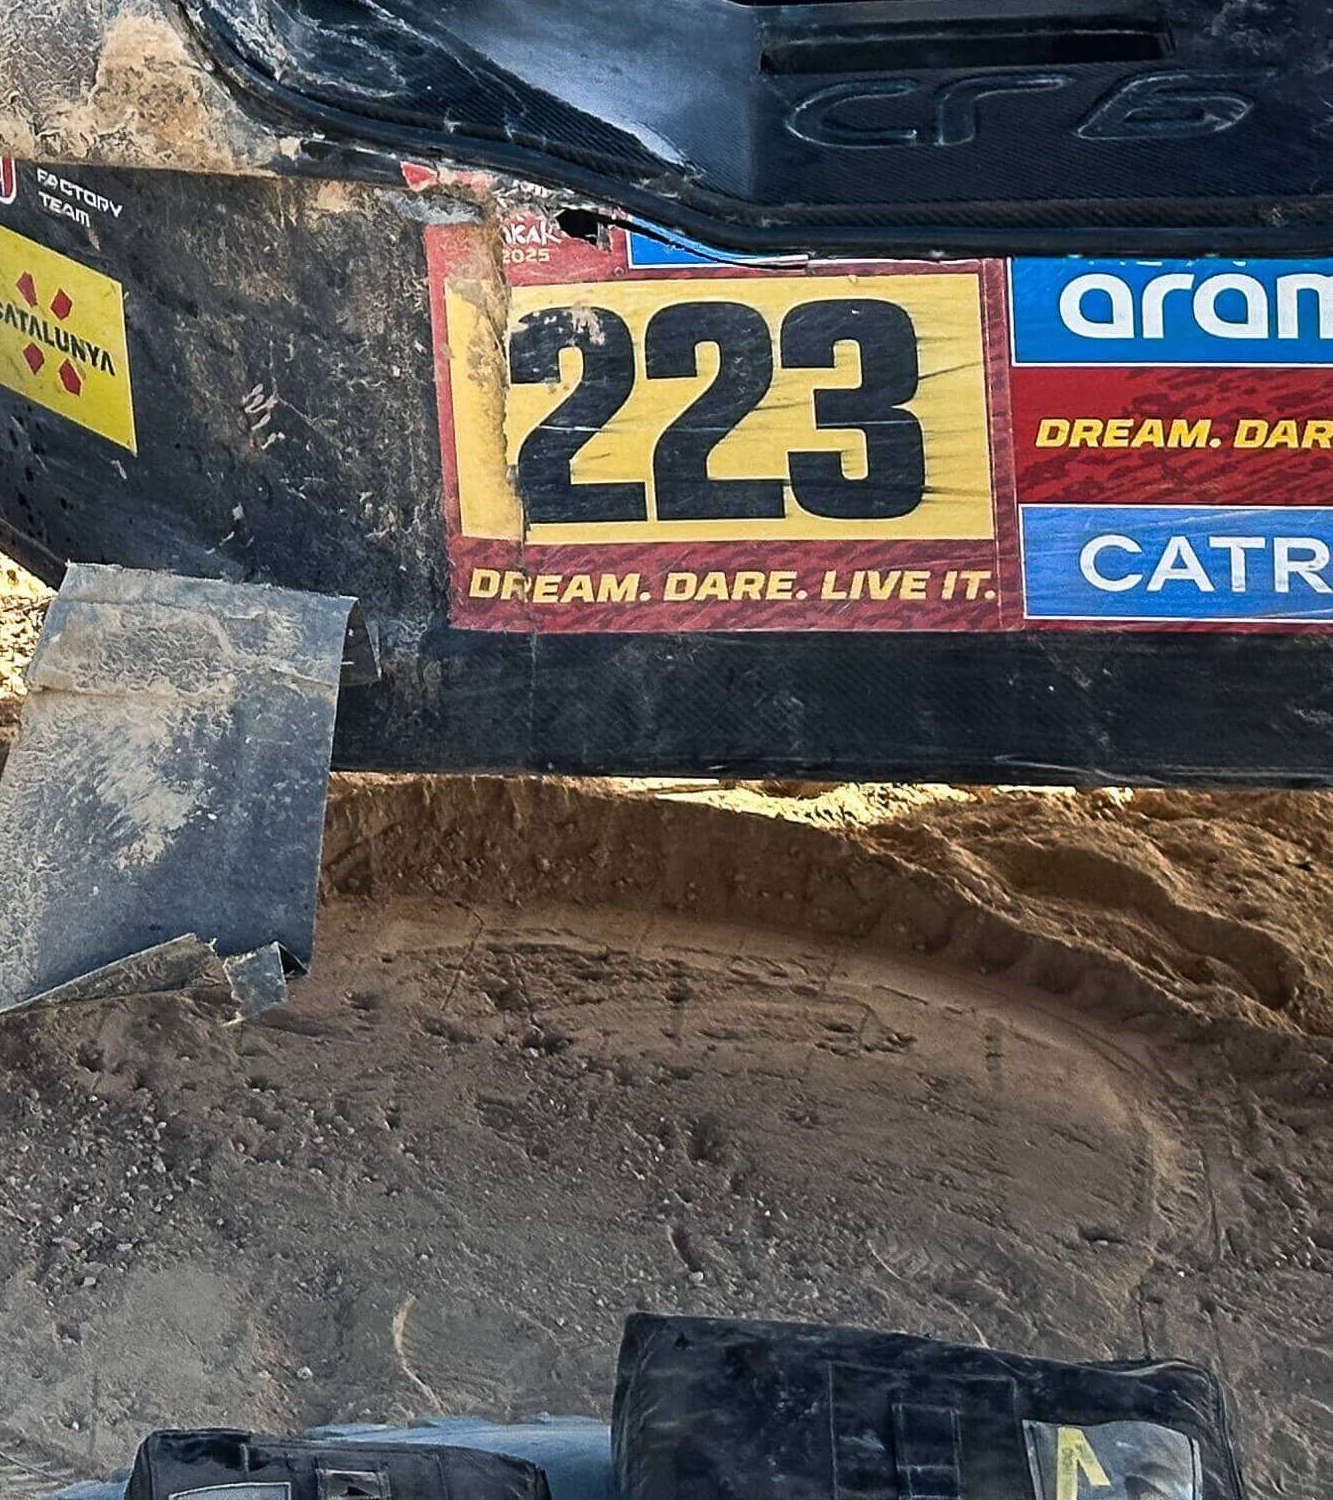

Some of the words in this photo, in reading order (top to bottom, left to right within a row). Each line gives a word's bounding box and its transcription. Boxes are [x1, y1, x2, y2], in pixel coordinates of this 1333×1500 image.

[37, 167, 123, 218] FACTORY
[38, 190, 91, 228] TEAM
[502, 247, 550, 264] 2025
[509, 298, 926, 524] 223
[1035, 418, 1221, 449] DREAM.
[469, 567, 652, 603] DREAM.
[663, 571, 808, 602] DARE.
[821, 570, 930, 602] LIVE
[941, 571, 997, 602] IT.
